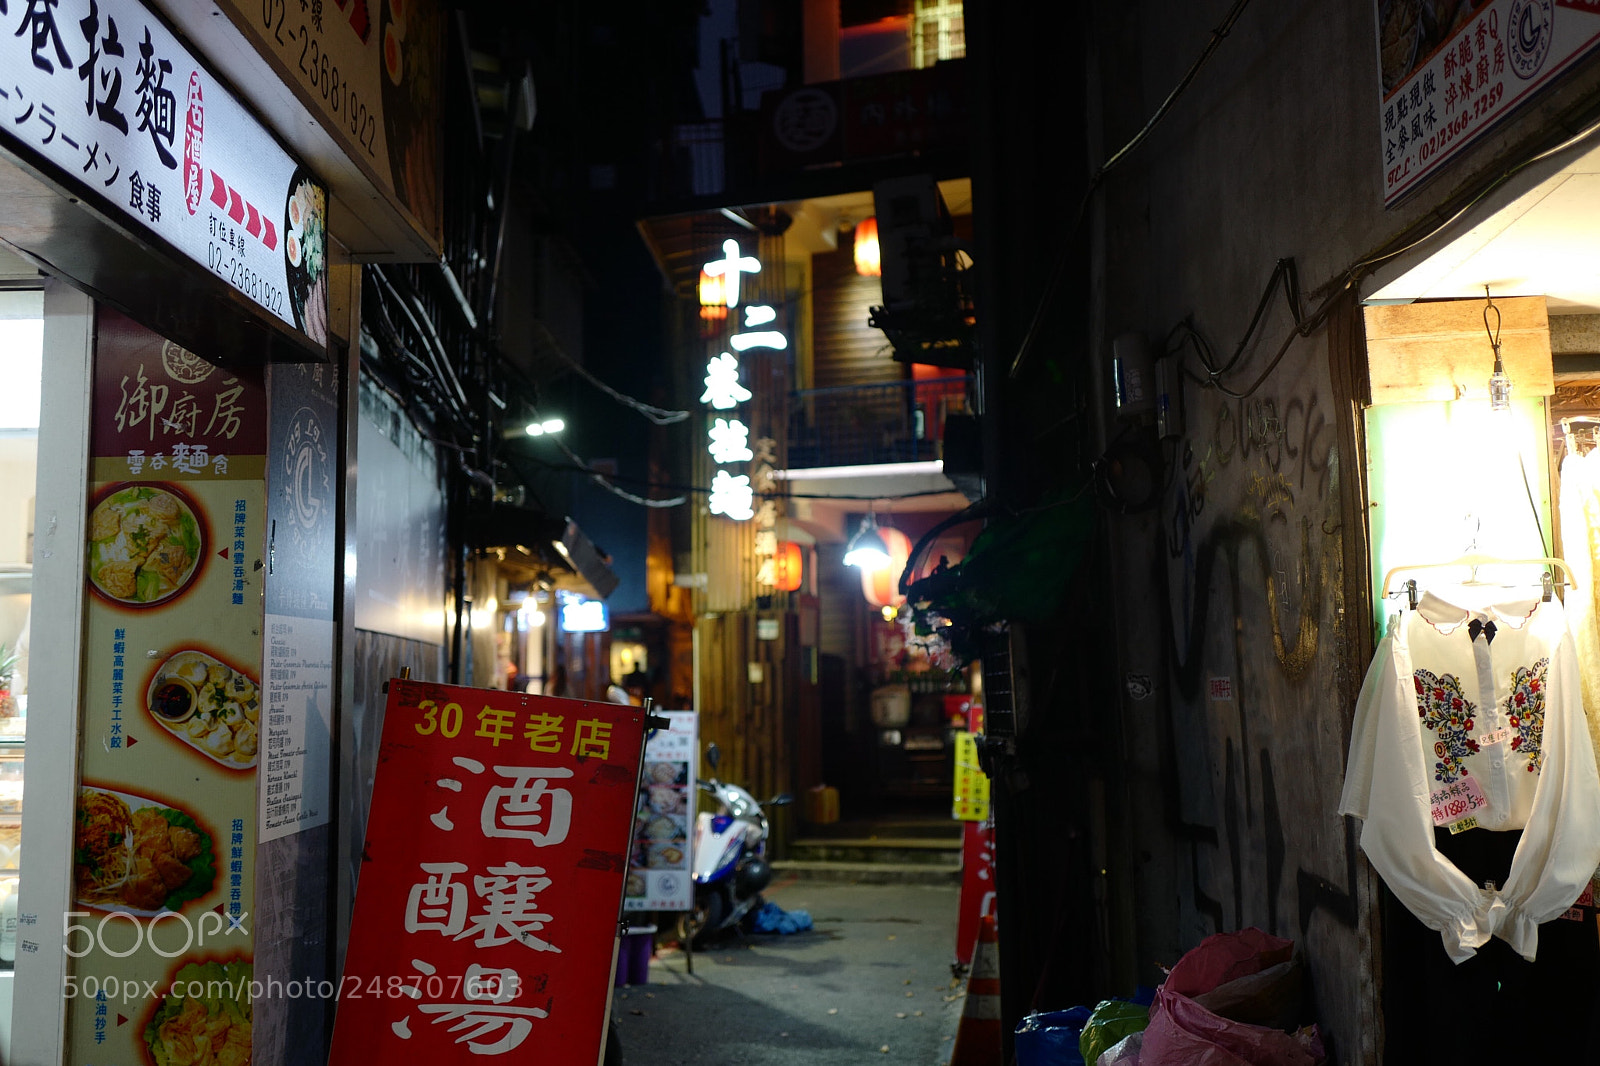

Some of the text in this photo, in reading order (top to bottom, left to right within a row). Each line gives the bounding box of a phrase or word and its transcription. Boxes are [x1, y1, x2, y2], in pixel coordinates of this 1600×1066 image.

[300, 0, 323, 34] 線
[1384, 68, 1436, 133] 現點現做
[1384, 101, 1438, 165] 全麥風味
[208, 241, 283, 316] 02-23681922
[127, 442, 229, 475] 雲吞麵食
[231, 499, 246, 605] 招牌菜肉雲吞湯麵
[110, 628, 125, 749] 鮮蝦高麗菜手工水餃
[391, 756, 574, 1056] 酒釀湯
